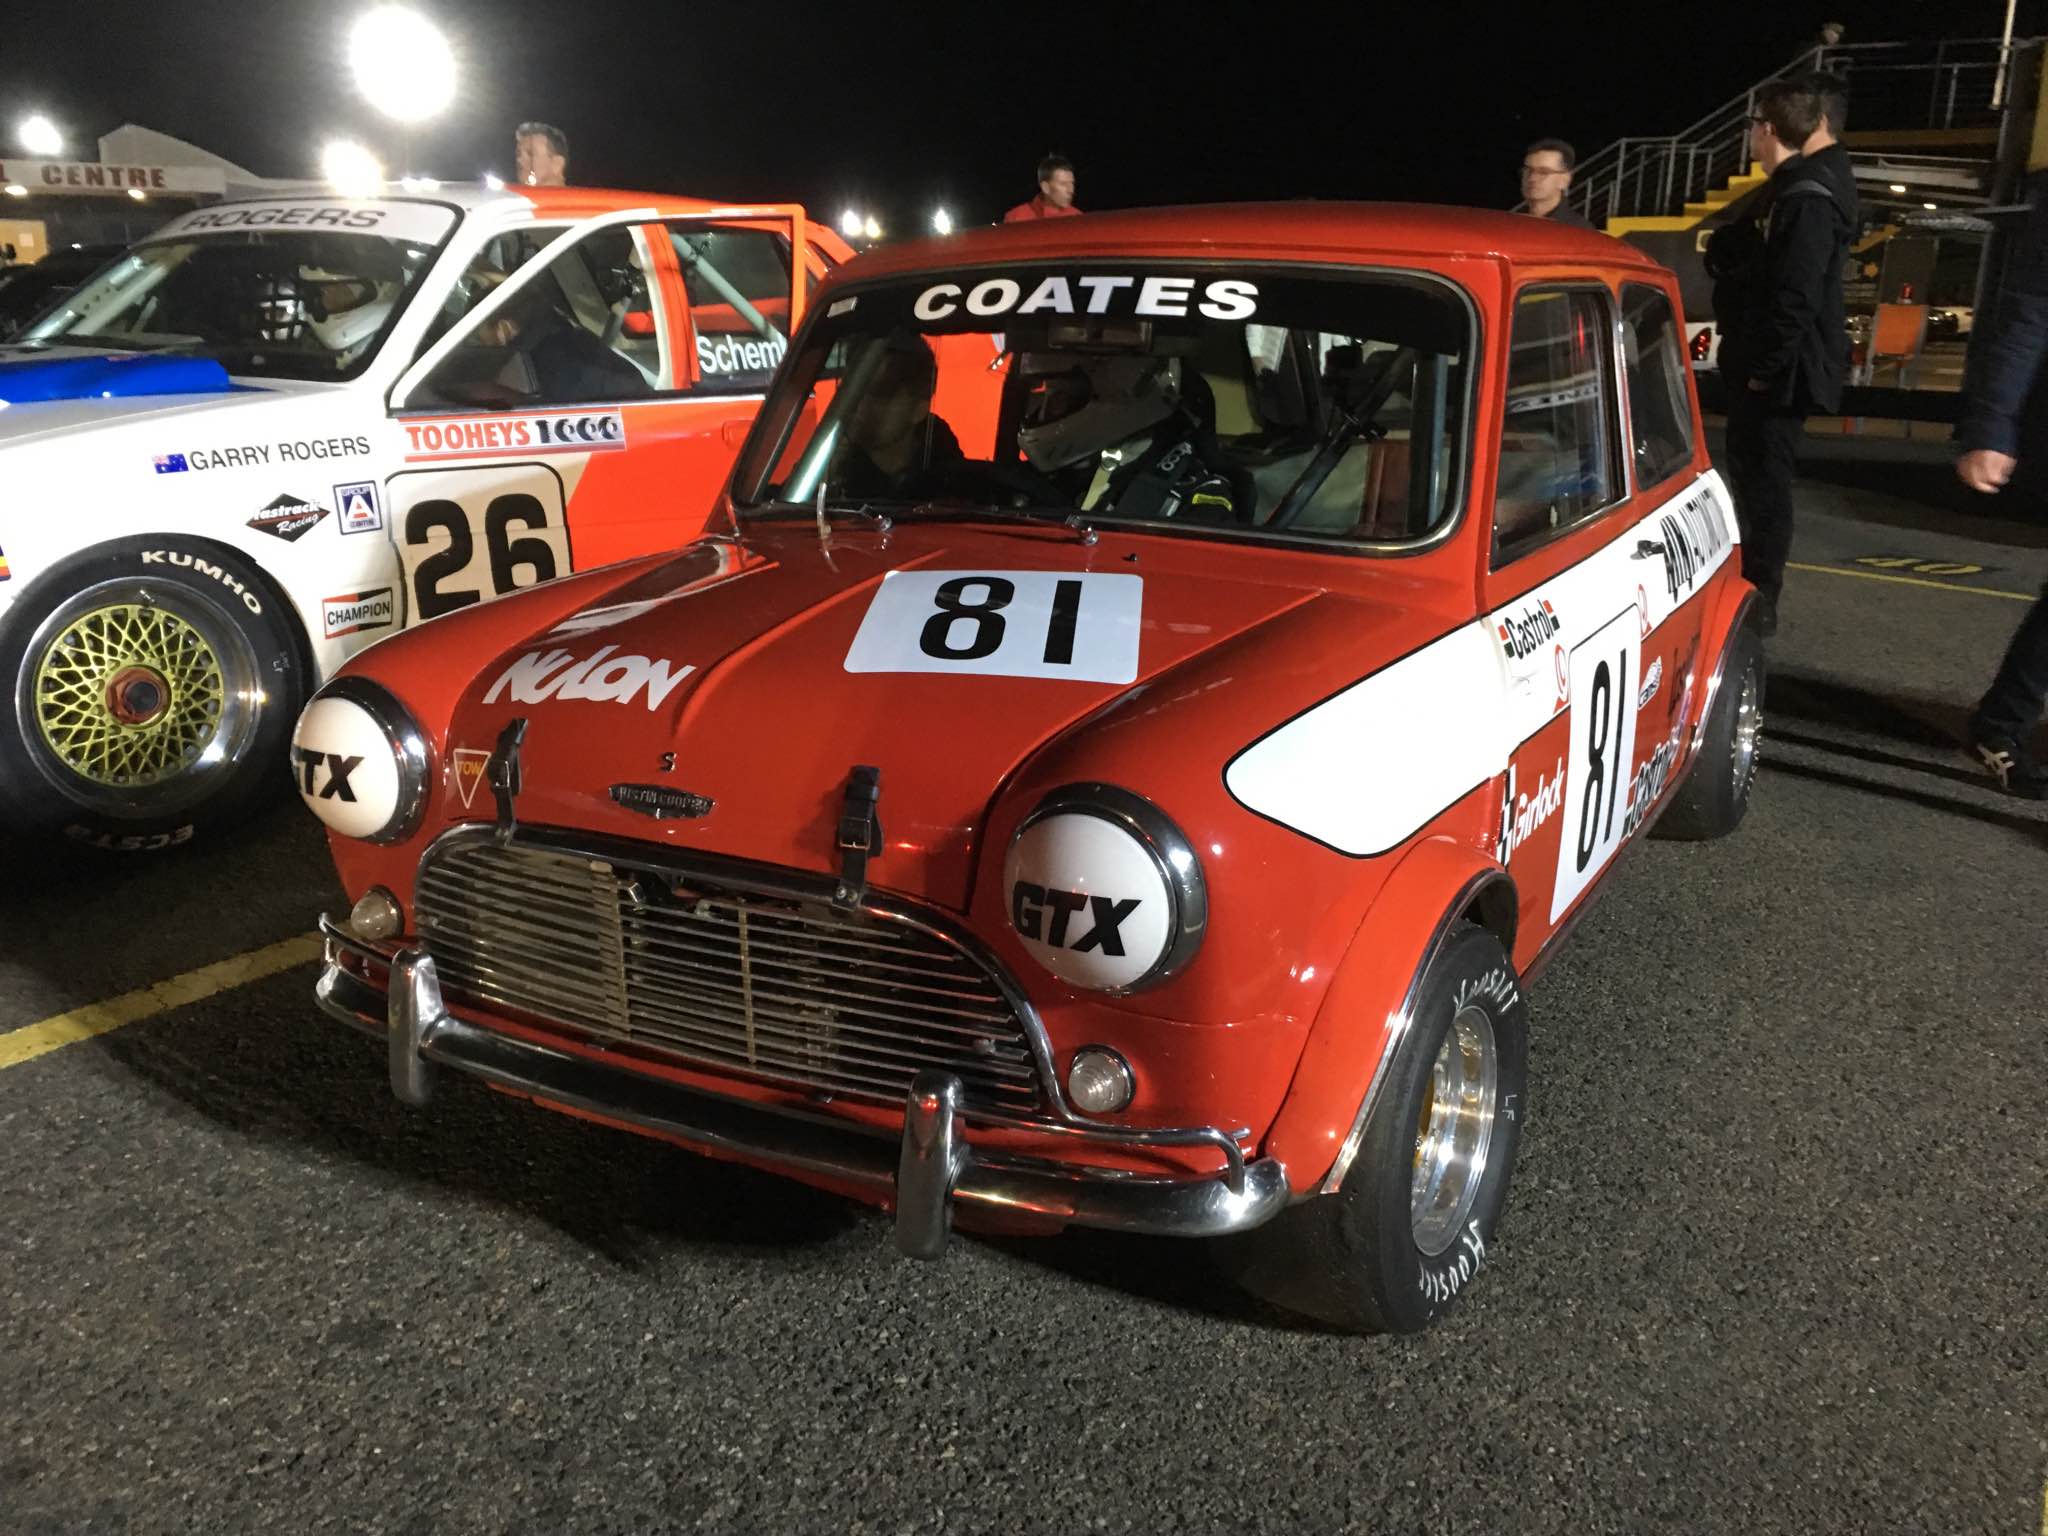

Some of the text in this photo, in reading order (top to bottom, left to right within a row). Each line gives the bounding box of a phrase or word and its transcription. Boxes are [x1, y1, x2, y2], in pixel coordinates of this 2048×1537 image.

[41, 164, 166, 188] CENTRE
[181, 207, 386, 231] ROGERS
[913, 276, 1259, 320] COATES
[190, 436, 371, 471] GARRY ROGERS
[405, 420, 531, 451] TOOHEYS
[405, 493, 556, 619] 26
[141, 550, 262, 616] KUMHO
[327, 601, 391, 626] CHAMPION
[919, 576, 1083, 665] 81
[1504, 599, 1554, 660] Castrol
[457, 760, 482, 776] TOW
[658, 751, 677, 773] S
[1577, 648, 1627, 874] 81
[1513, 757, 1565, 850] Girlock
[1012, 880, 1143, 957] GTX
